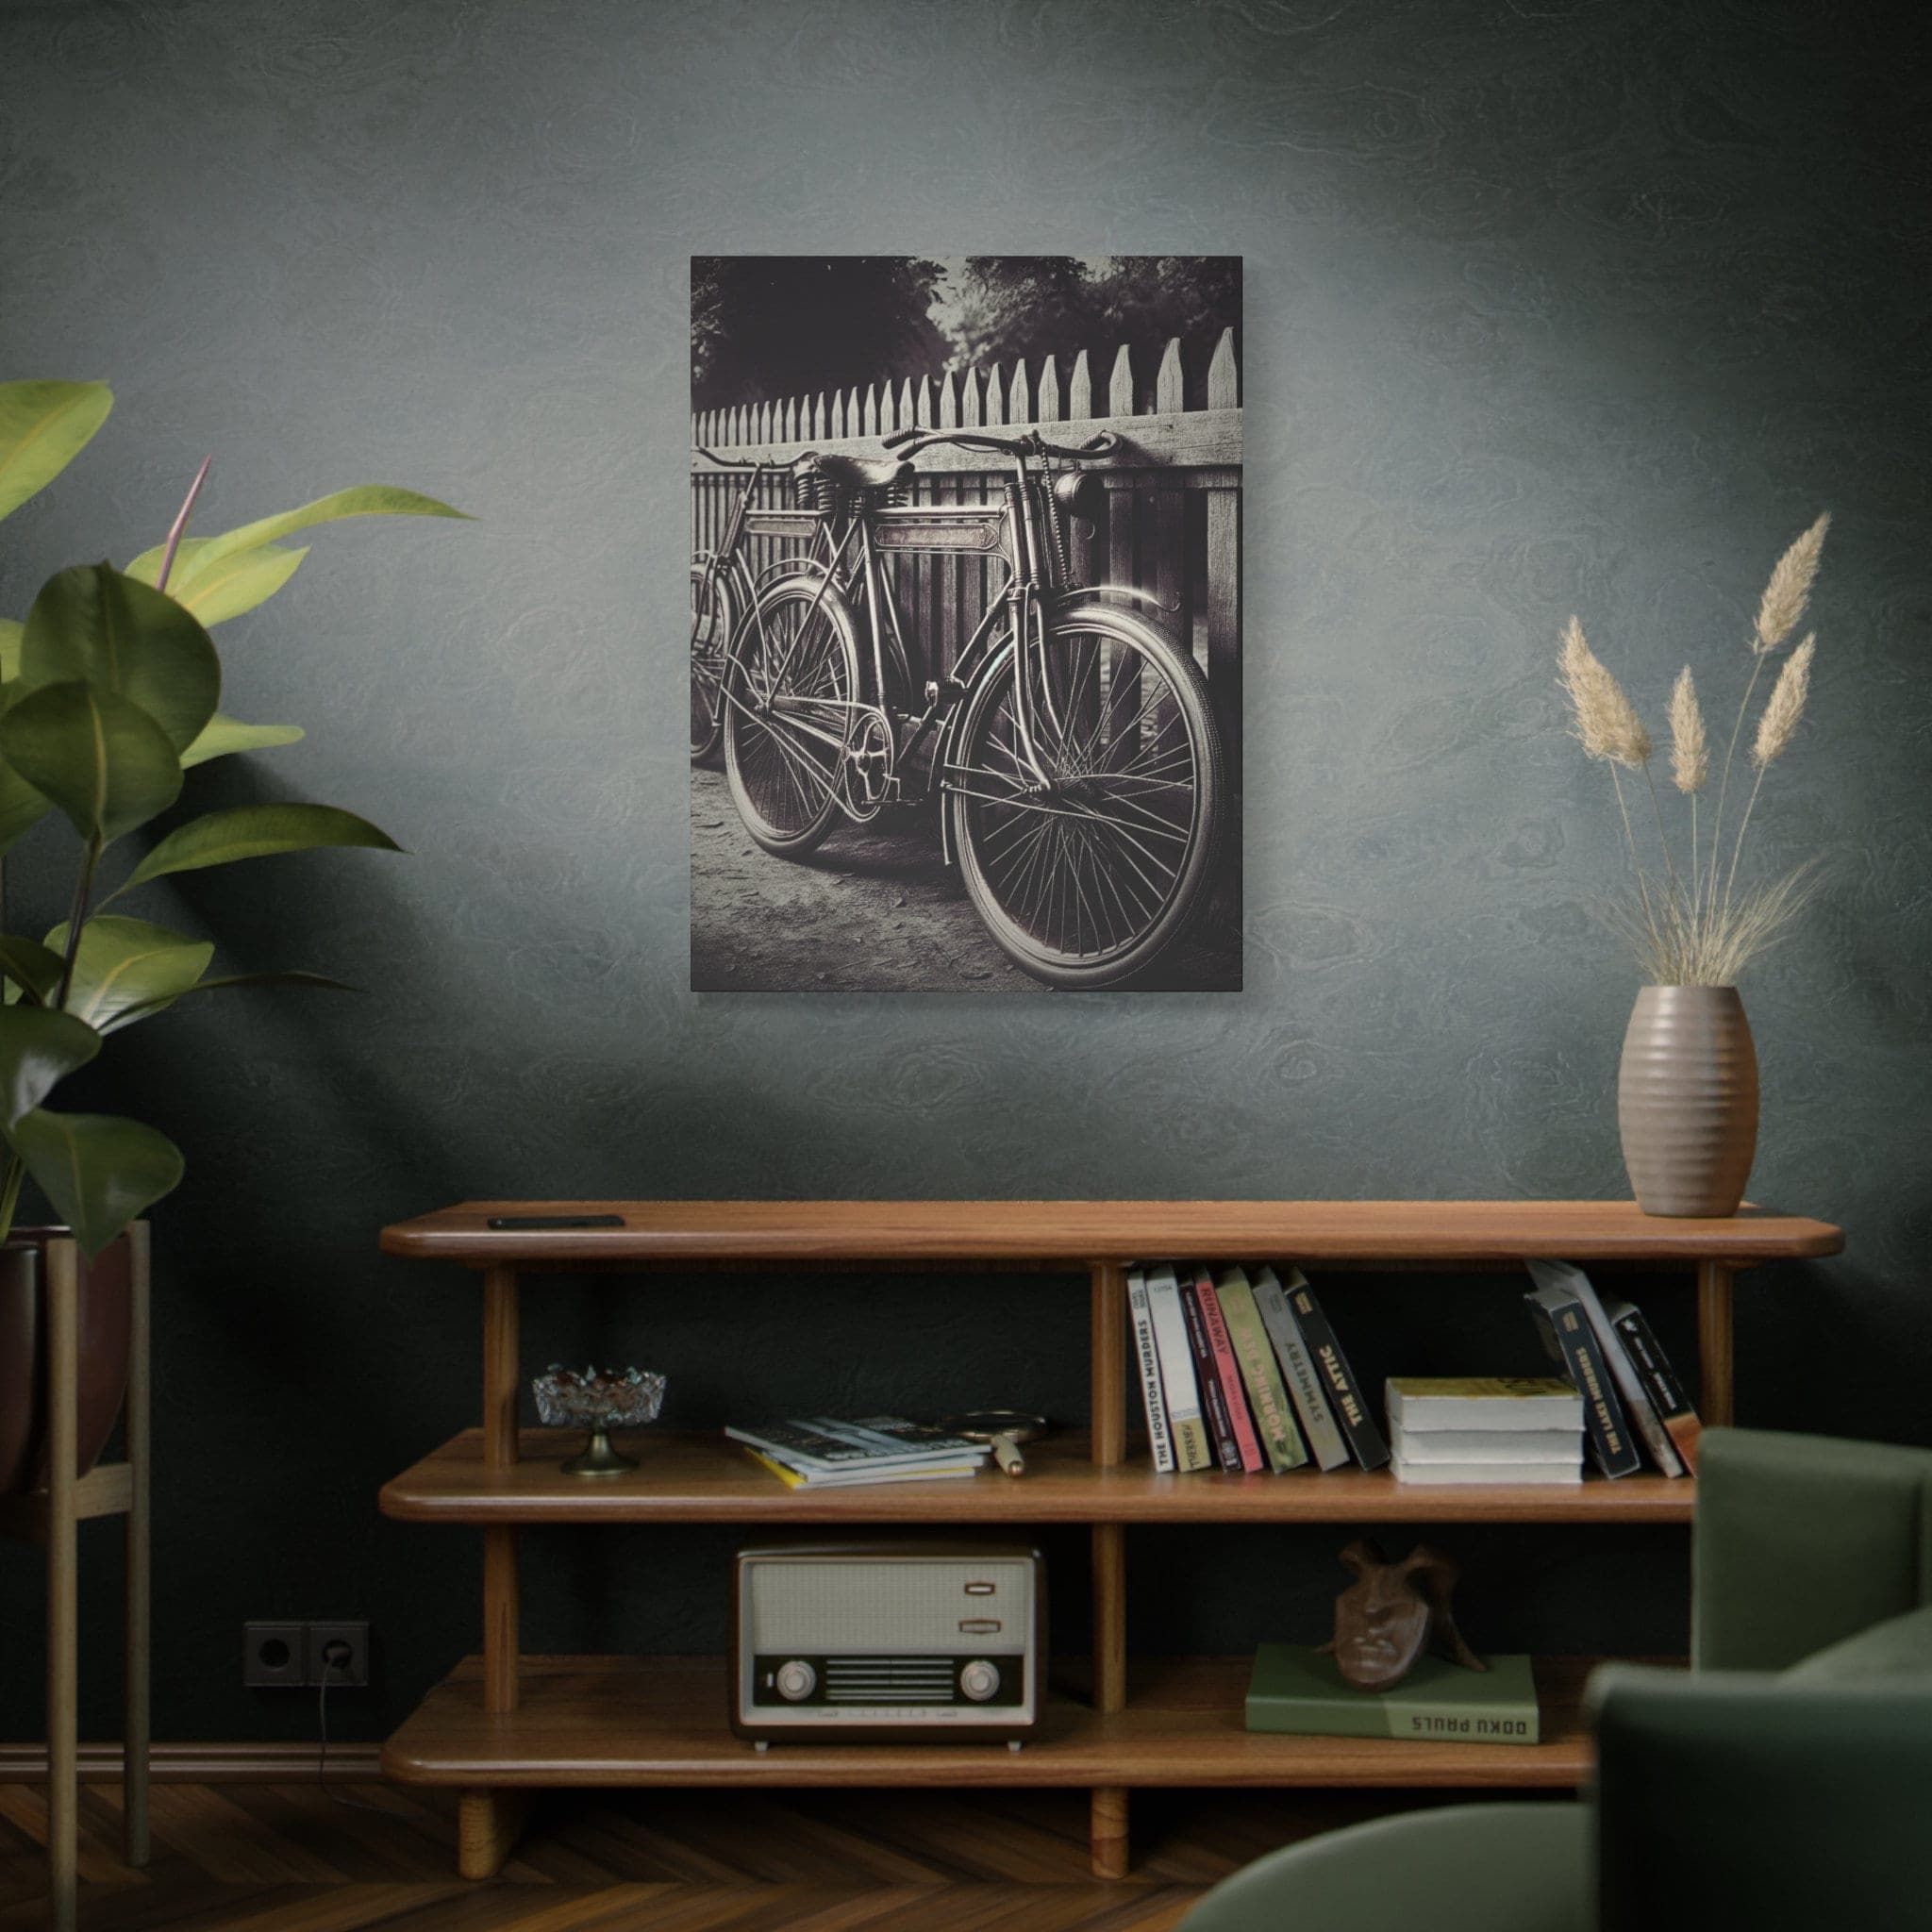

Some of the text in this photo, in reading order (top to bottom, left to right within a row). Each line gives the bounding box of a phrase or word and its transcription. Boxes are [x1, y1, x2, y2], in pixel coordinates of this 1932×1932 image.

[1137, 1319, 1155, 1376] MURDERS
[1201, 1288, 1228, 1356] RUNAWAY
[1146, 1380, 1164, 1440] HOUSTON
[1251, 1363, 1288, 1442] MORNING
[1286, 1341, 1324, 1423] SYMMETRY
[1319, 1343, 1364, 1427] THE ATTIC
[1157, 1443, 1169, 1465] THE
[1605, 1431, 1622, 1454] THE
[1412, 1717, 1469, 1732] PAULS
